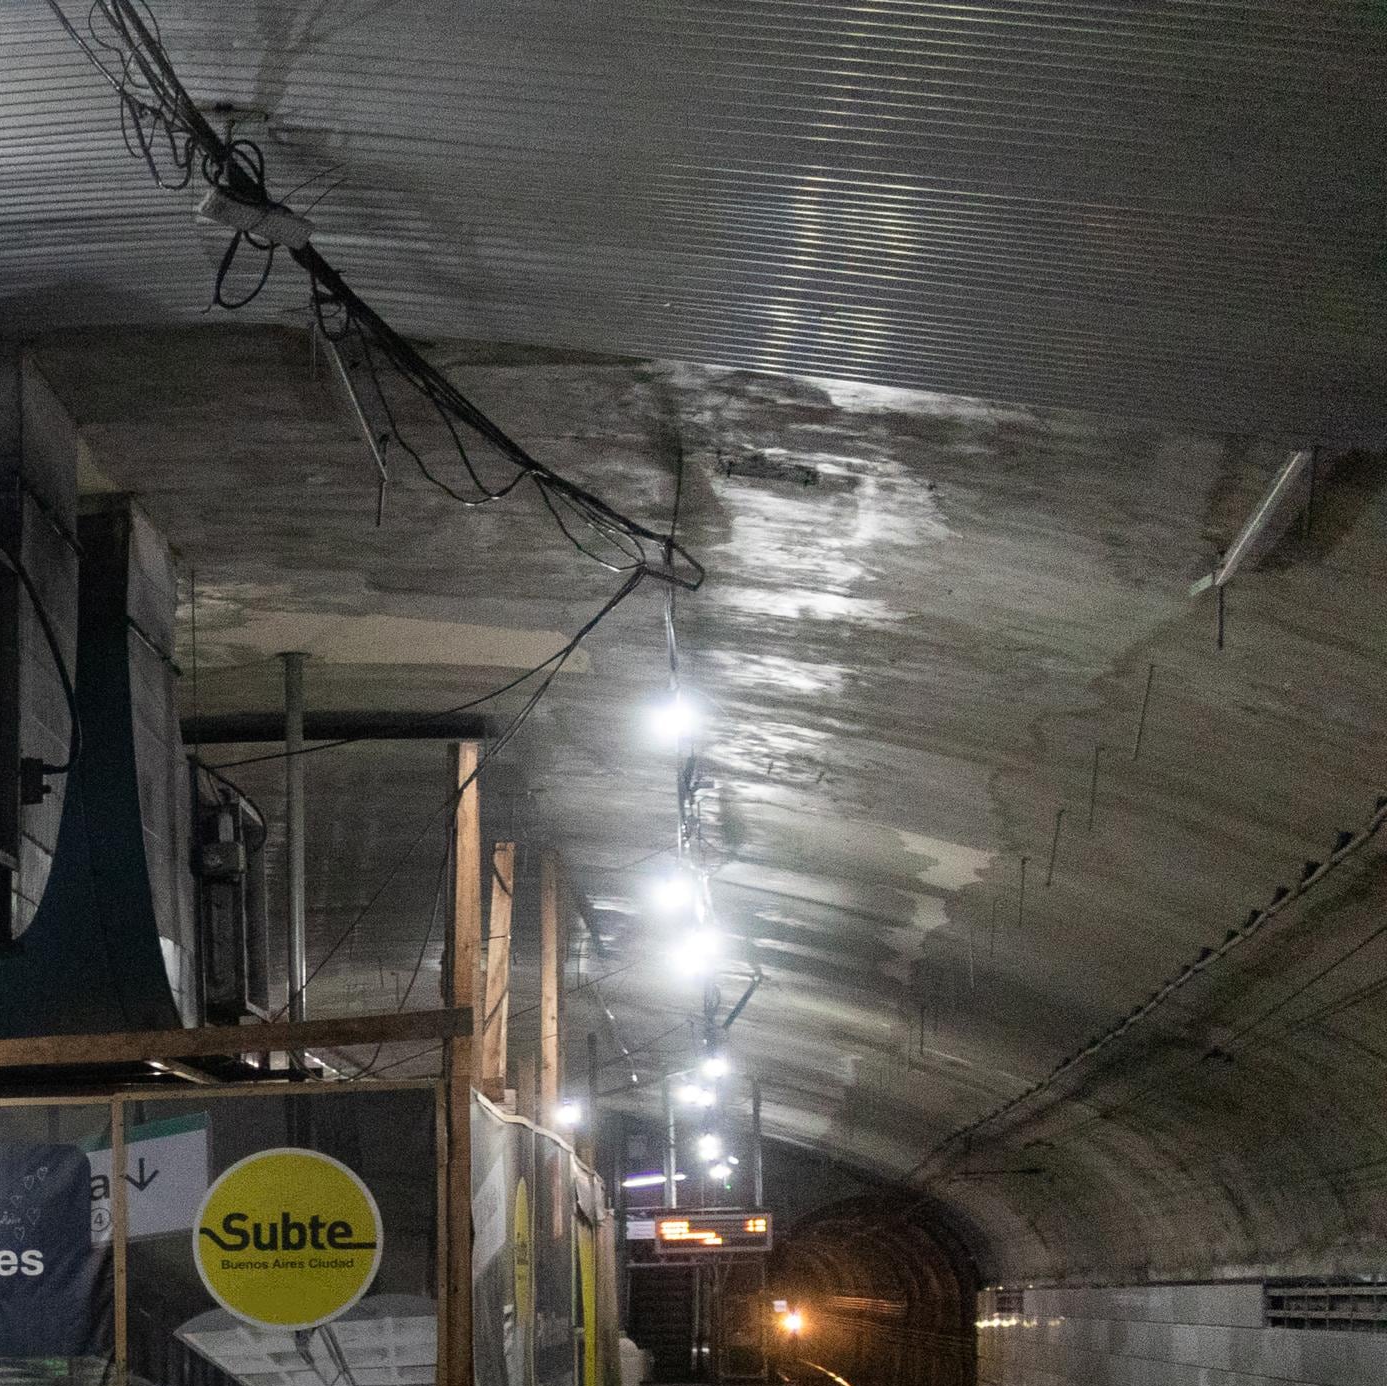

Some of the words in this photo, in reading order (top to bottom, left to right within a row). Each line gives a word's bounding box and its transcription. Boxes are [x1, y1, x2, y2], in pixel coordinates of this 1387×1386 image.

[93, 1212, 104, 1227] 4
[199, 1212, 377, 1251] Subte
[221, 1259, 268, 1270] Buenos
[271, 1258, 305, 1270] Aires
[308, 1257, 355, 1269] Ciudad
